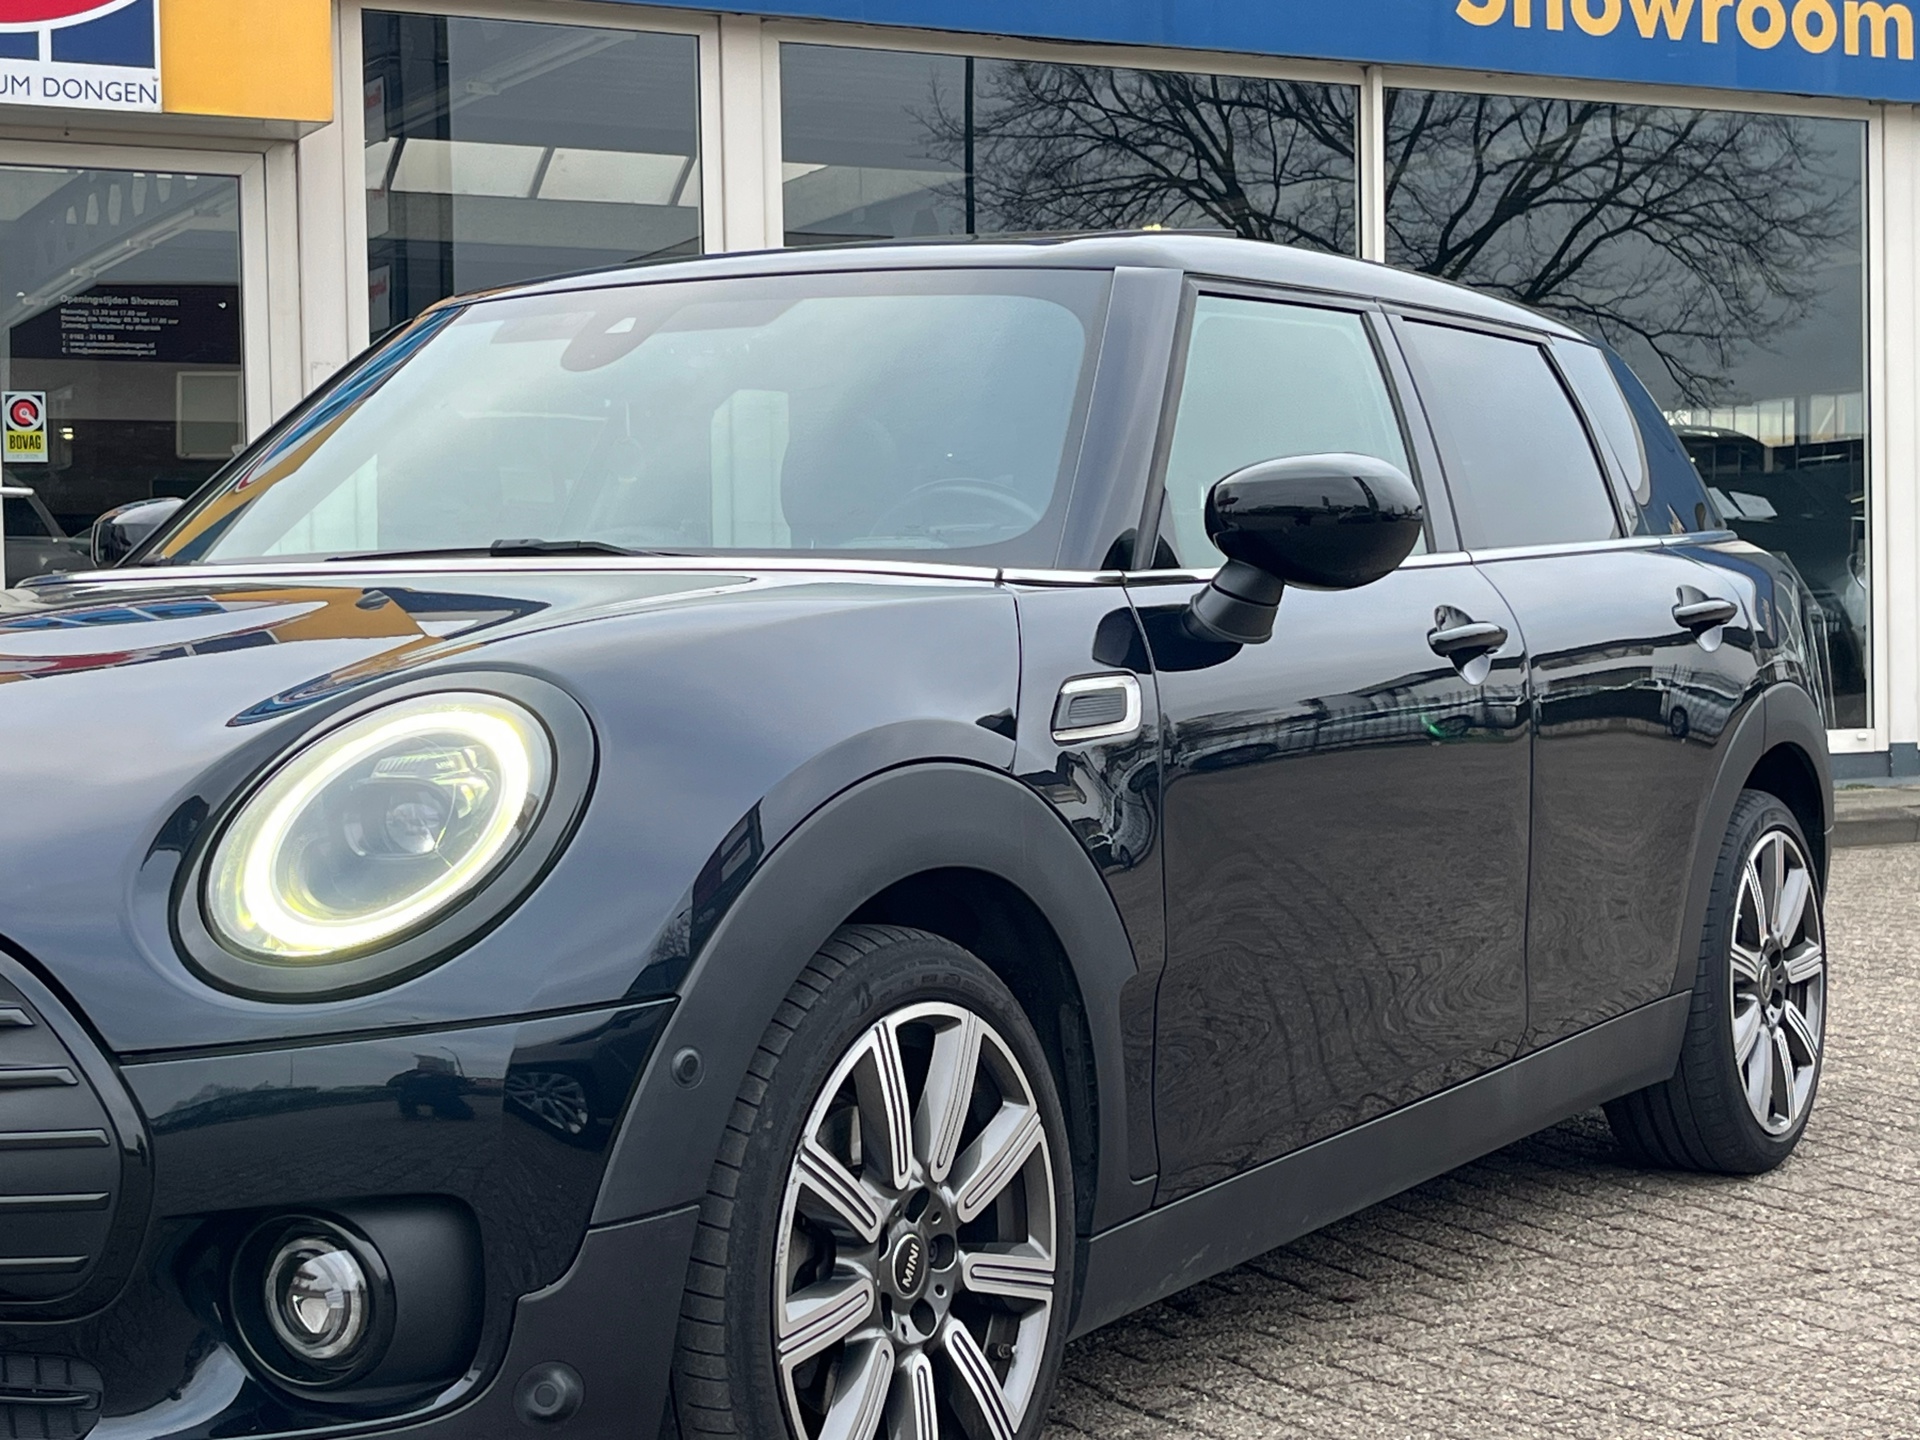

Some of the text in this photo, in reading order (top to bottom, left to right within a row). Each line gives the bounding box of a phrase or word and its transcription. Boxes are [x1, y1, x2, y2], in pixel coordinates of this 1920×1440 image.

[43, 77, 157, 104] DONGEN
[60, 294, 179, 306] Openingstijden Showroom
[9, 435, 42, 450] BOVAG
[902, 1242, 920, 1288] MINI
